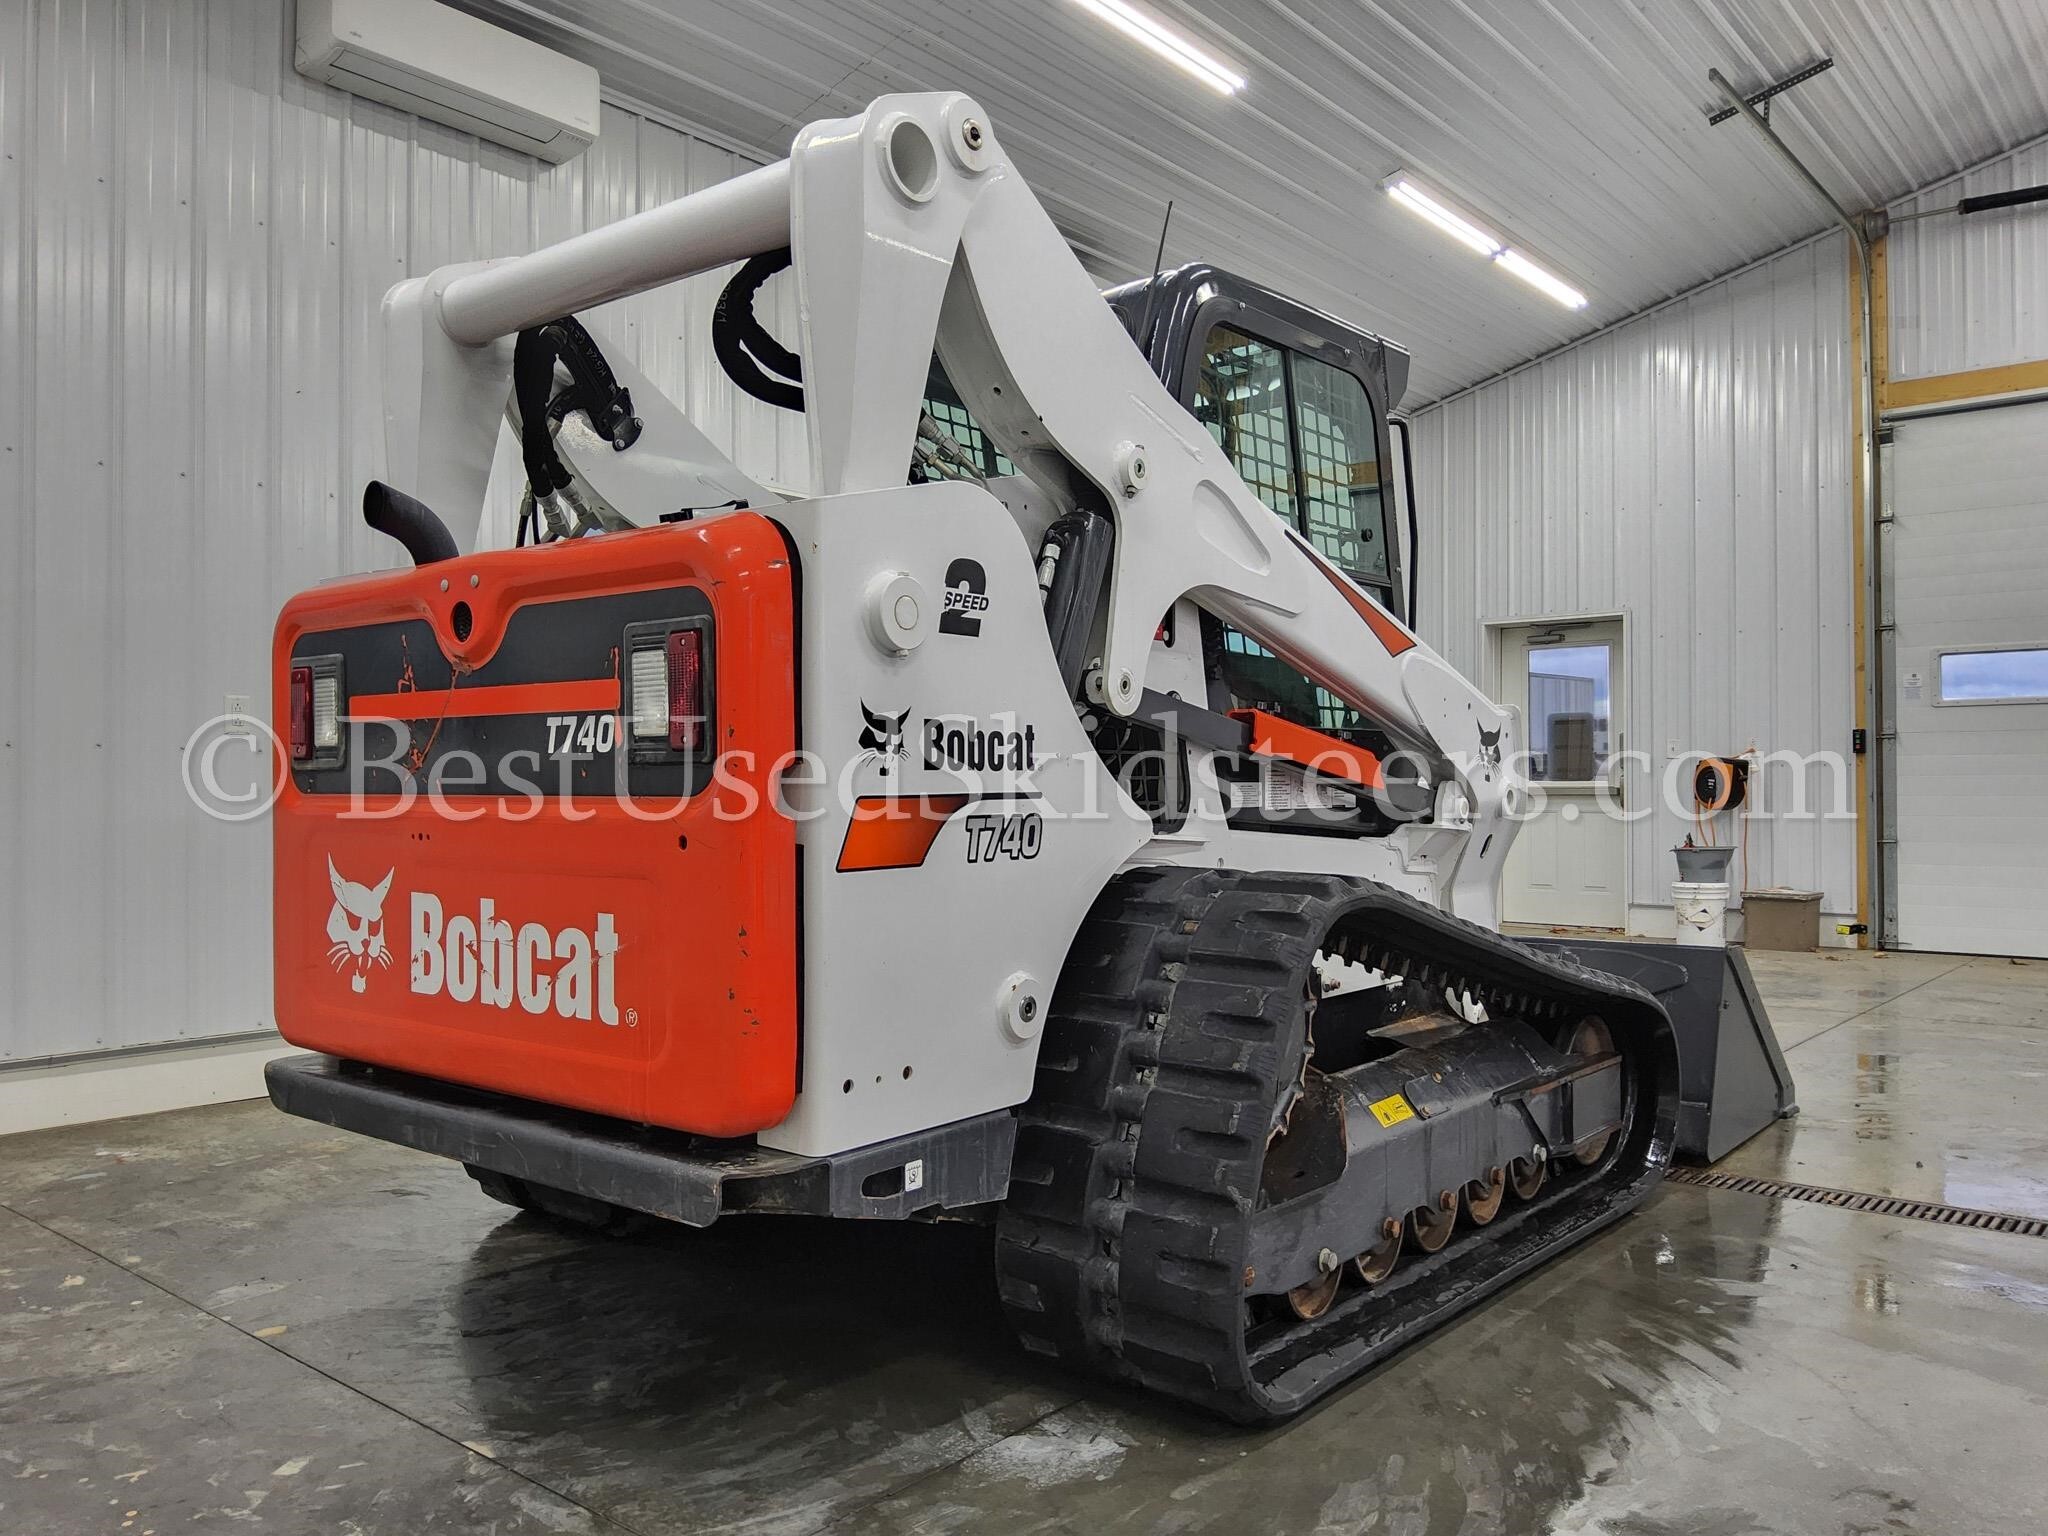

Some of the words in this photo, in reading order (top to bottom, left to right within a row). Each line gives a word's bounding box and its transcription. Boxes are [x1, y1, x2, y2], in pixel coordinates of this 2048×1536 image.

[944, 591, 989, 611] SPEED
[546, 714, 615, 754] T740
[924, 718, 1035, 772] Bobcat
[965, 812, 1043, 863] T740
[410, 891, 620, 1026] Bobcat
